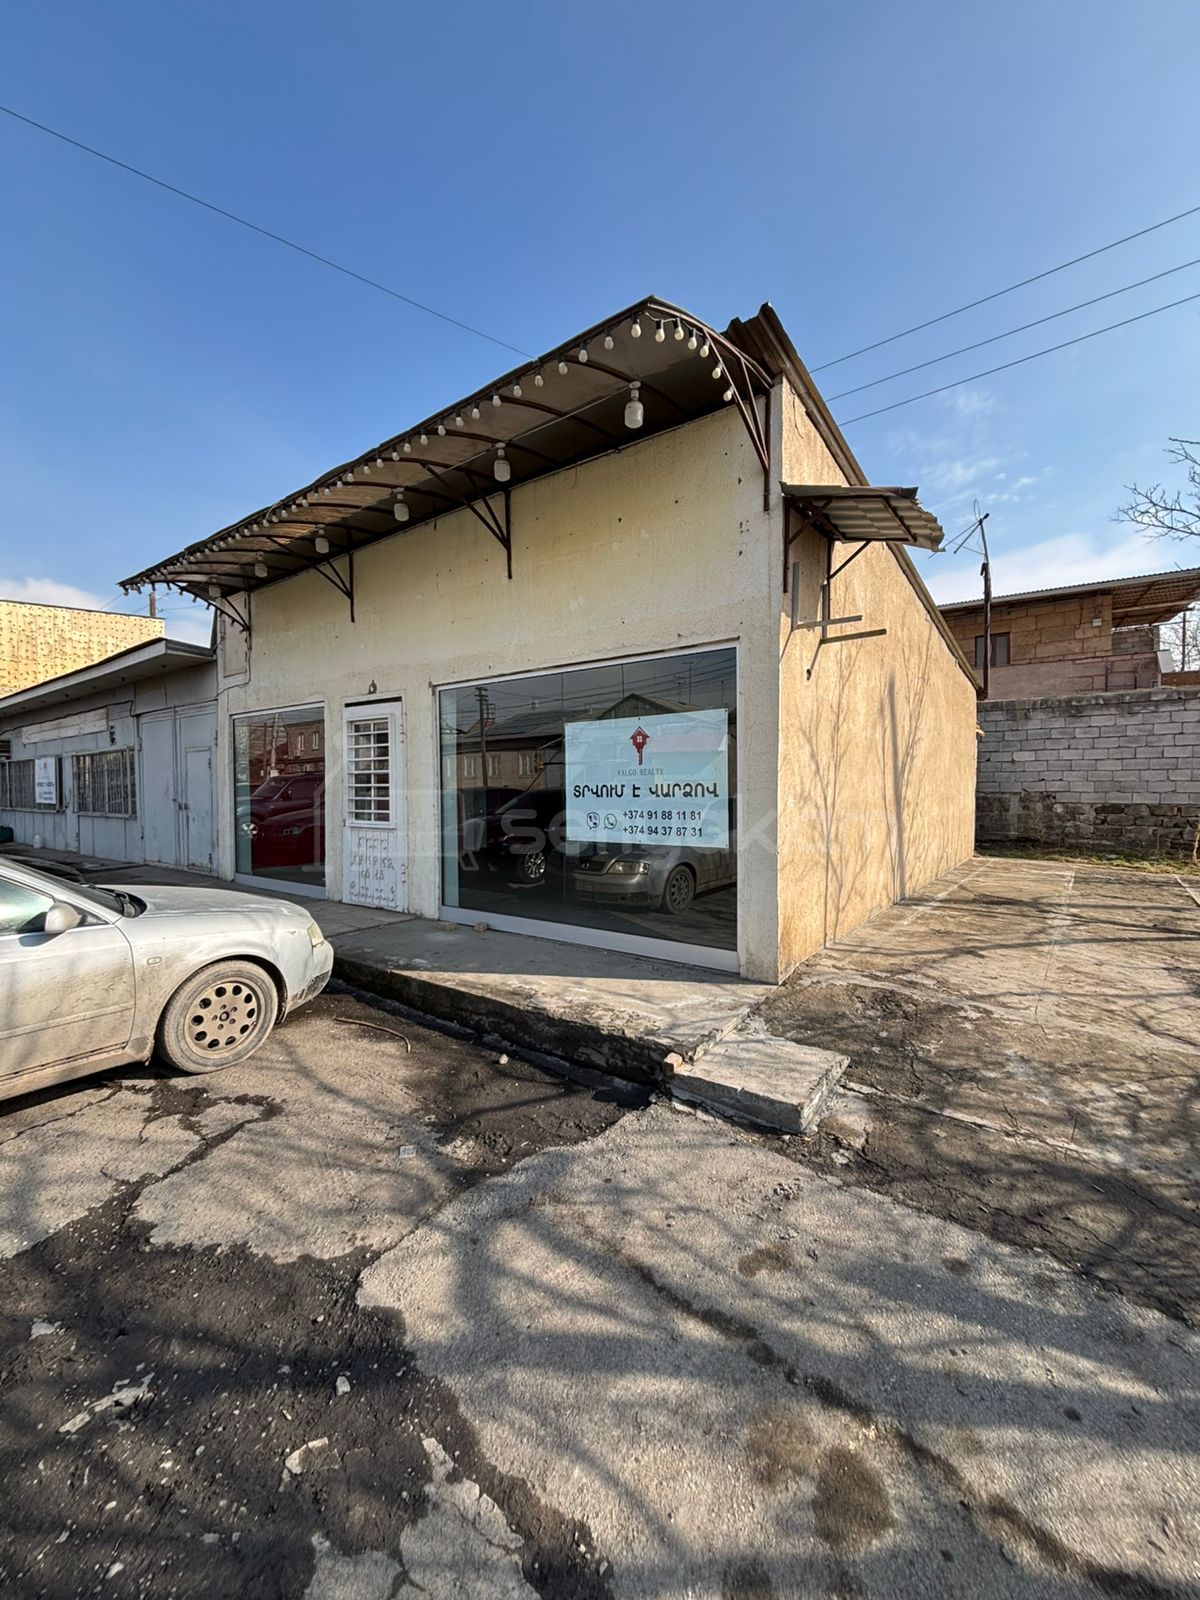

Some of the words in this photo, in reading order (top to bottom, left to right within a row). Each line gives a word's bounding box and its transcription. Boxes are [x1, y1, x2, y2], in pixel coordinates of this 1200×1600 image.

[640, 768, 664, 776] REALTY
[573, 784, 625, 798] ՏՐՎՈՒՄ
[632, 784, 641, 798] Է
[649, 783, 719, 798] ՎԱՐՁՈՎ
[622, 810, 645, 820] +374
[647, 810, 658, 820] 91
[661, 811, 673, 820] 88
[676, 811, 686, 821] 11
[690, 811, 702, 821] 81
[622, 825, 645, 836] +374
[647, 826, 659, 836] 94
[661, 826, 673, 836] 37
[676, 827, 687, 837] 87
[691, 827, 703, 837] 31
